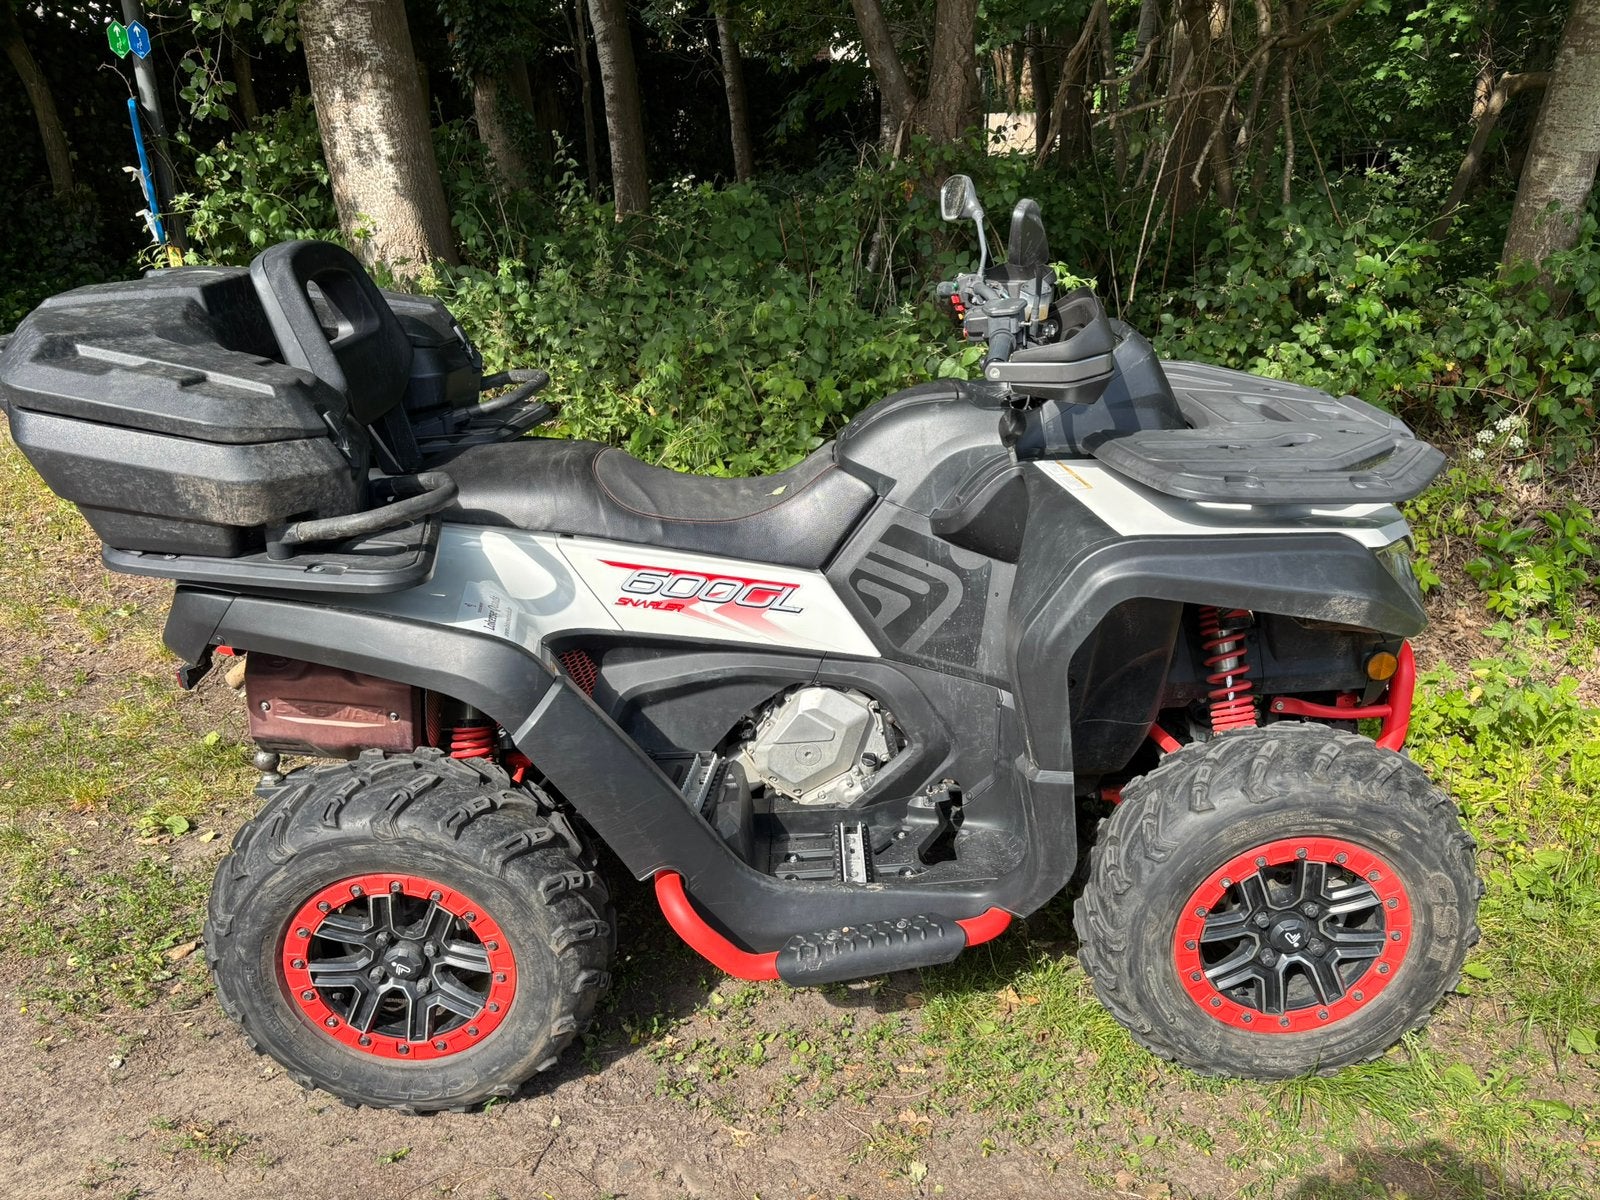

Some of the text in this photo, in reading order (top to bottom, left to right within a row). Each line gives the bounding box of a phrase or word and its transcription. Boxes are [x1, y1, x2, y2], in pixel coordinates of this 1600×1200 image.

[615, 597, 685, 612] SNARLER
[1427, 872, 1461, 973] CST
[373, 1071, 479, 1101] CST
